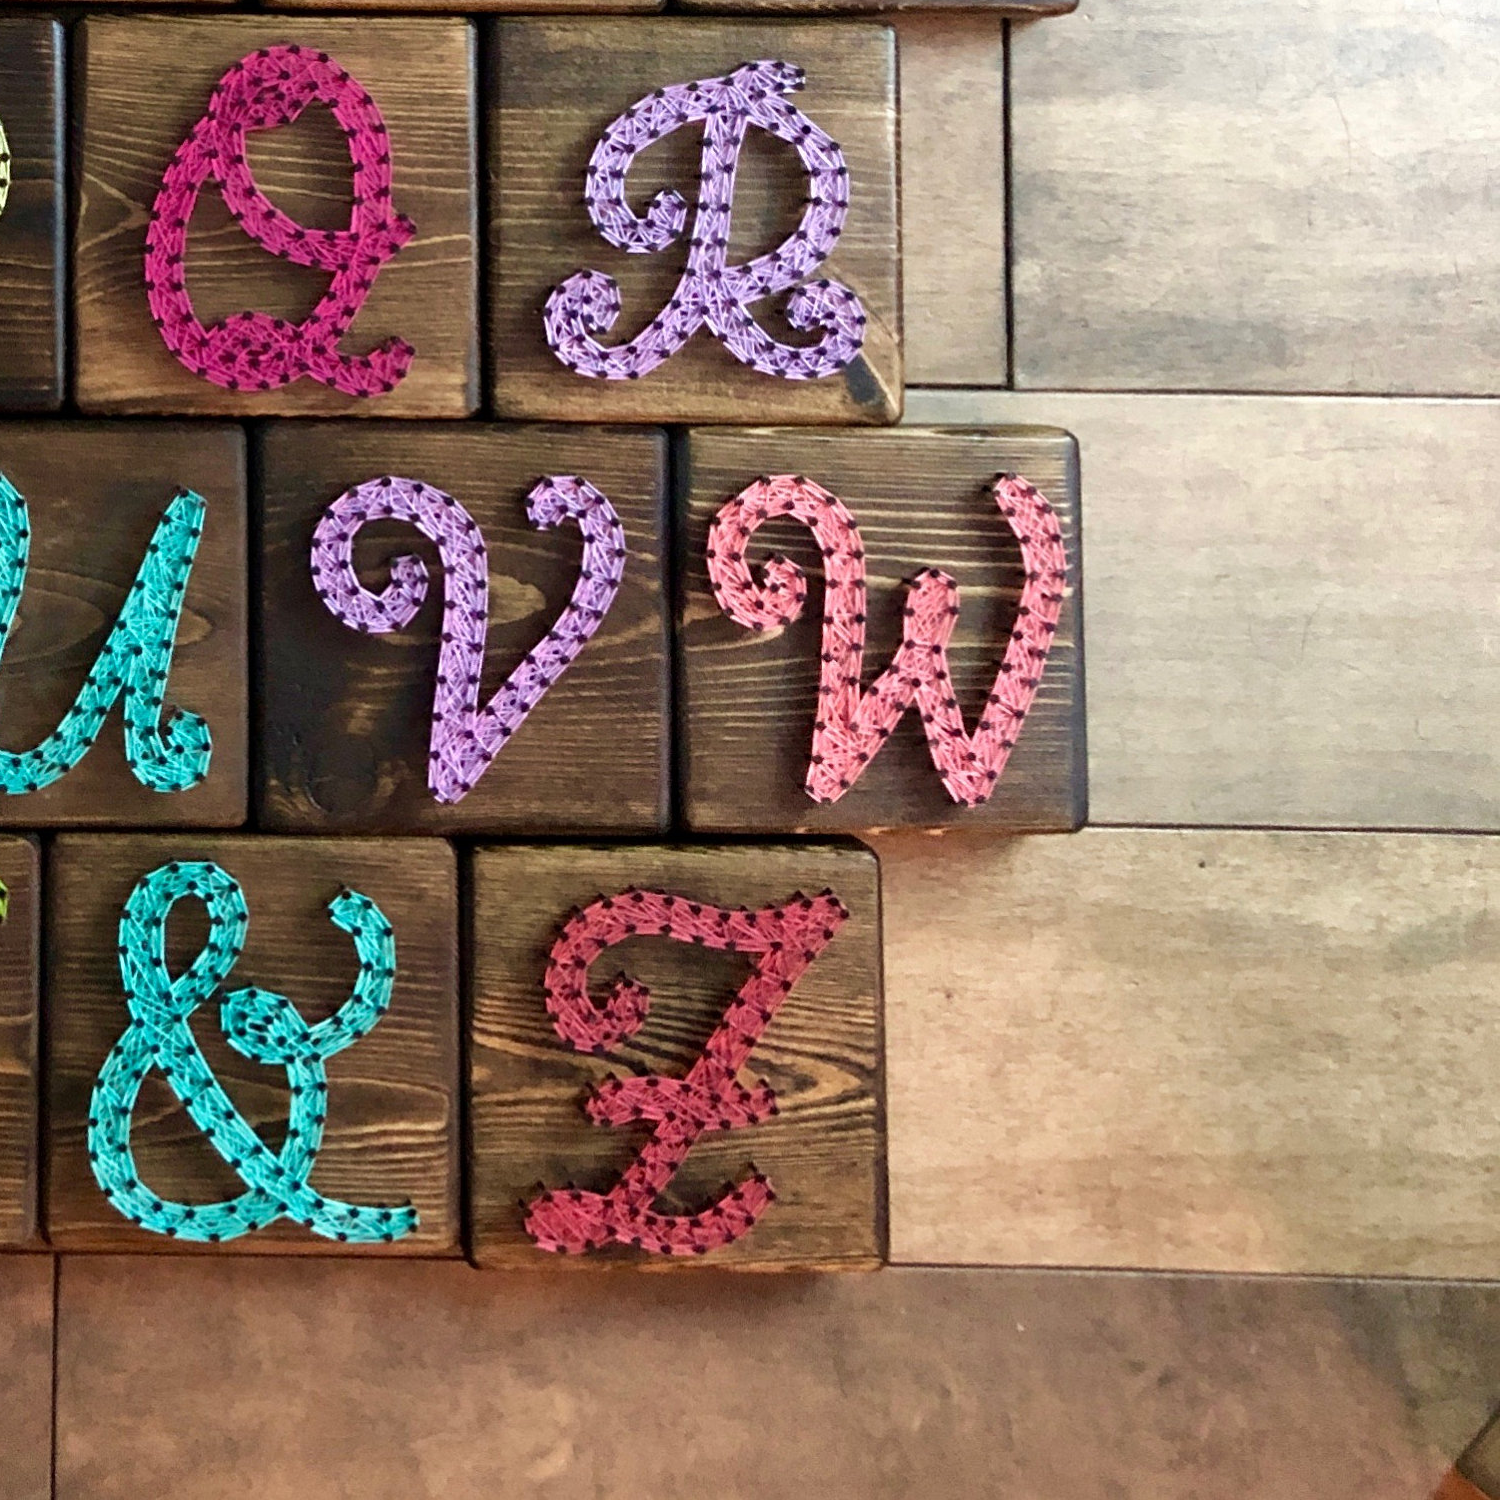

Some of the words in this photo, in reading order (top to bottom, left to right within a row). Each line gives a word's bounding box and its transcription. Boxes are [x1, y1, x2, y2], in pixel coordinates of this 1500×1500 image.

[145, 46, 412, 396] Q
[544, 60, 866, 380] R
[311, 476, 625, 802] V
[708, 474, 1069, 809] W
[88, 862, 418, 1242] &
[525, 891, 846, 1256] Z
